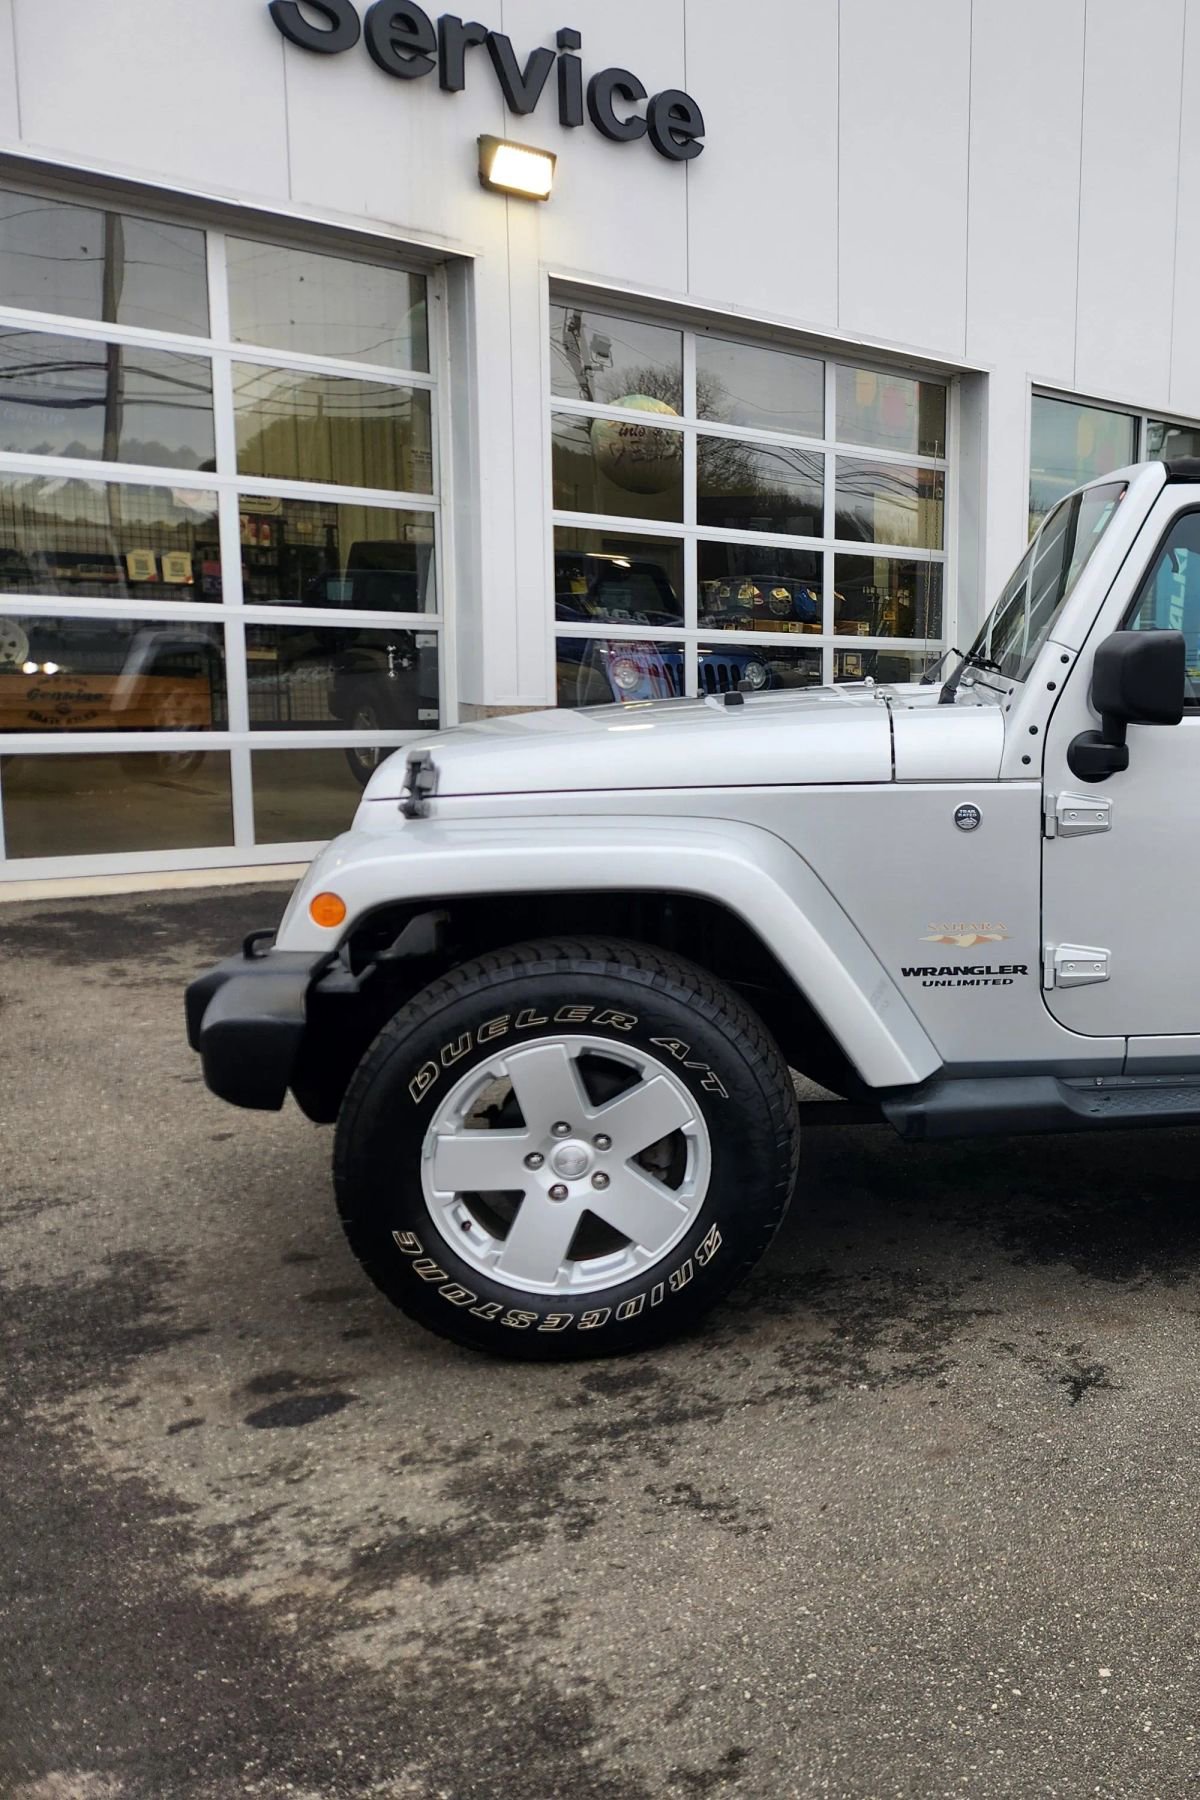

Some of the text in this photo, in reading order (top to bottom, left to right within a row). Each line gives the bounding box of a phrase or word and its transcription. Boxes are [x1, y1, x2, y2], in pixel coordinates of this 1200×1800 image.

[927, 922, 1008, 931] SAHARA
[901, 964, 1028, 977] WRANGLER
[921, 978, 1014, 988] UNLIMITED
[407, 1005, 729, 1104] DUELER A/T
[391, 1222, 724, 1332] BRIDGESTONE
